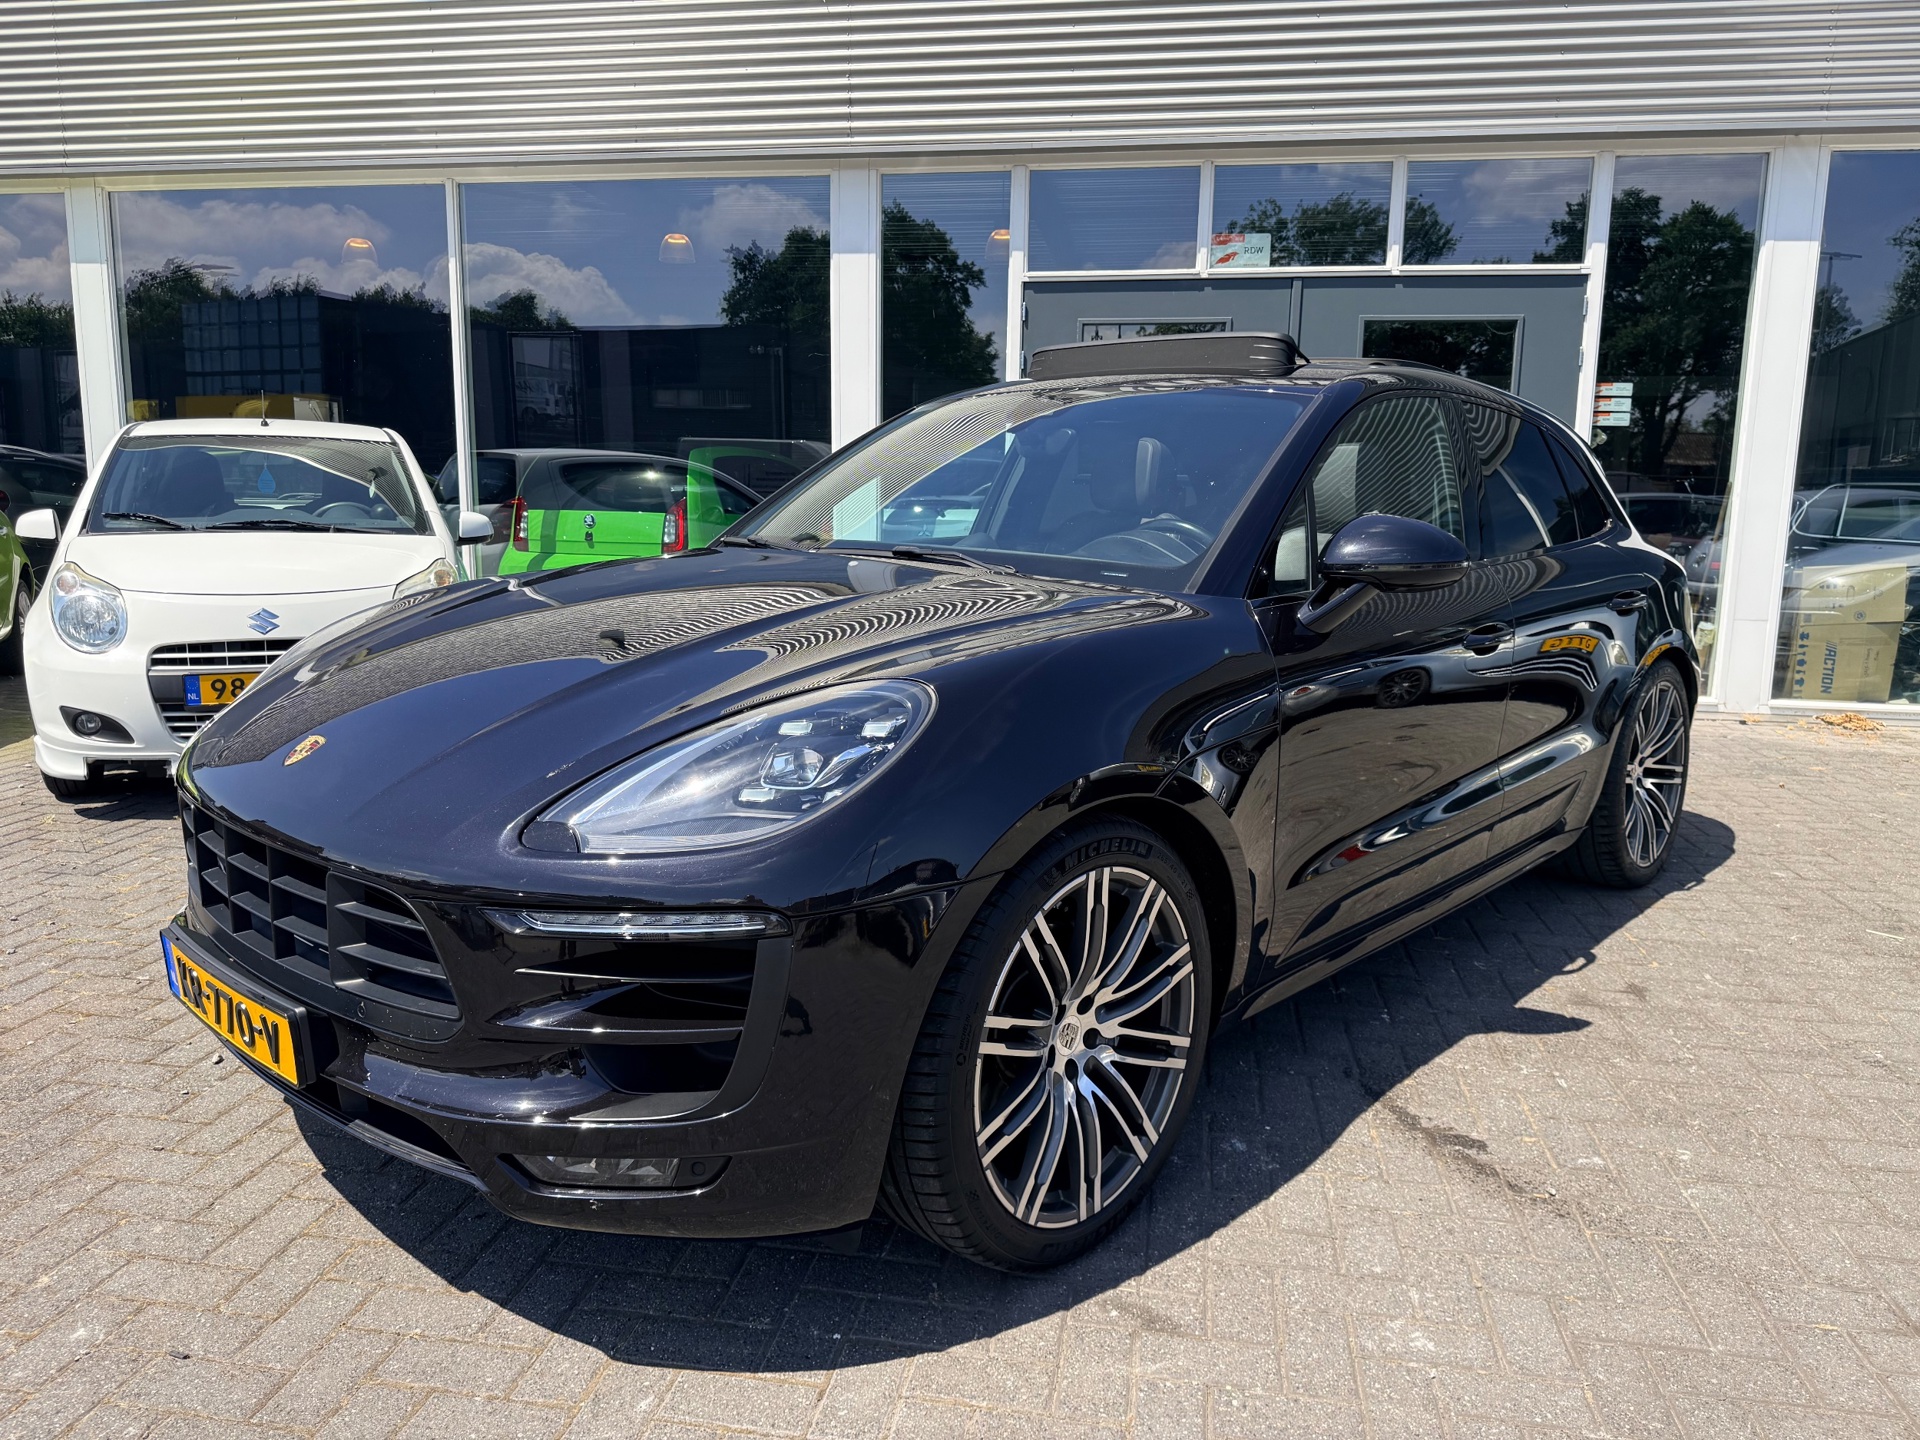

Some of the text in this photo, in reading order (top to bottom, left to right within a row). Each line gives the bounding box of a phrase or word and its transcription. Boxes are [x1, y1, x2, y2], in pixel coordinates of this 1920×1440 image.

[1243, 246, 1264, 254] RDW
[1820, 648, 1837, 694] ACTION
[1064, 837, 1150, 871] MICHELIN
